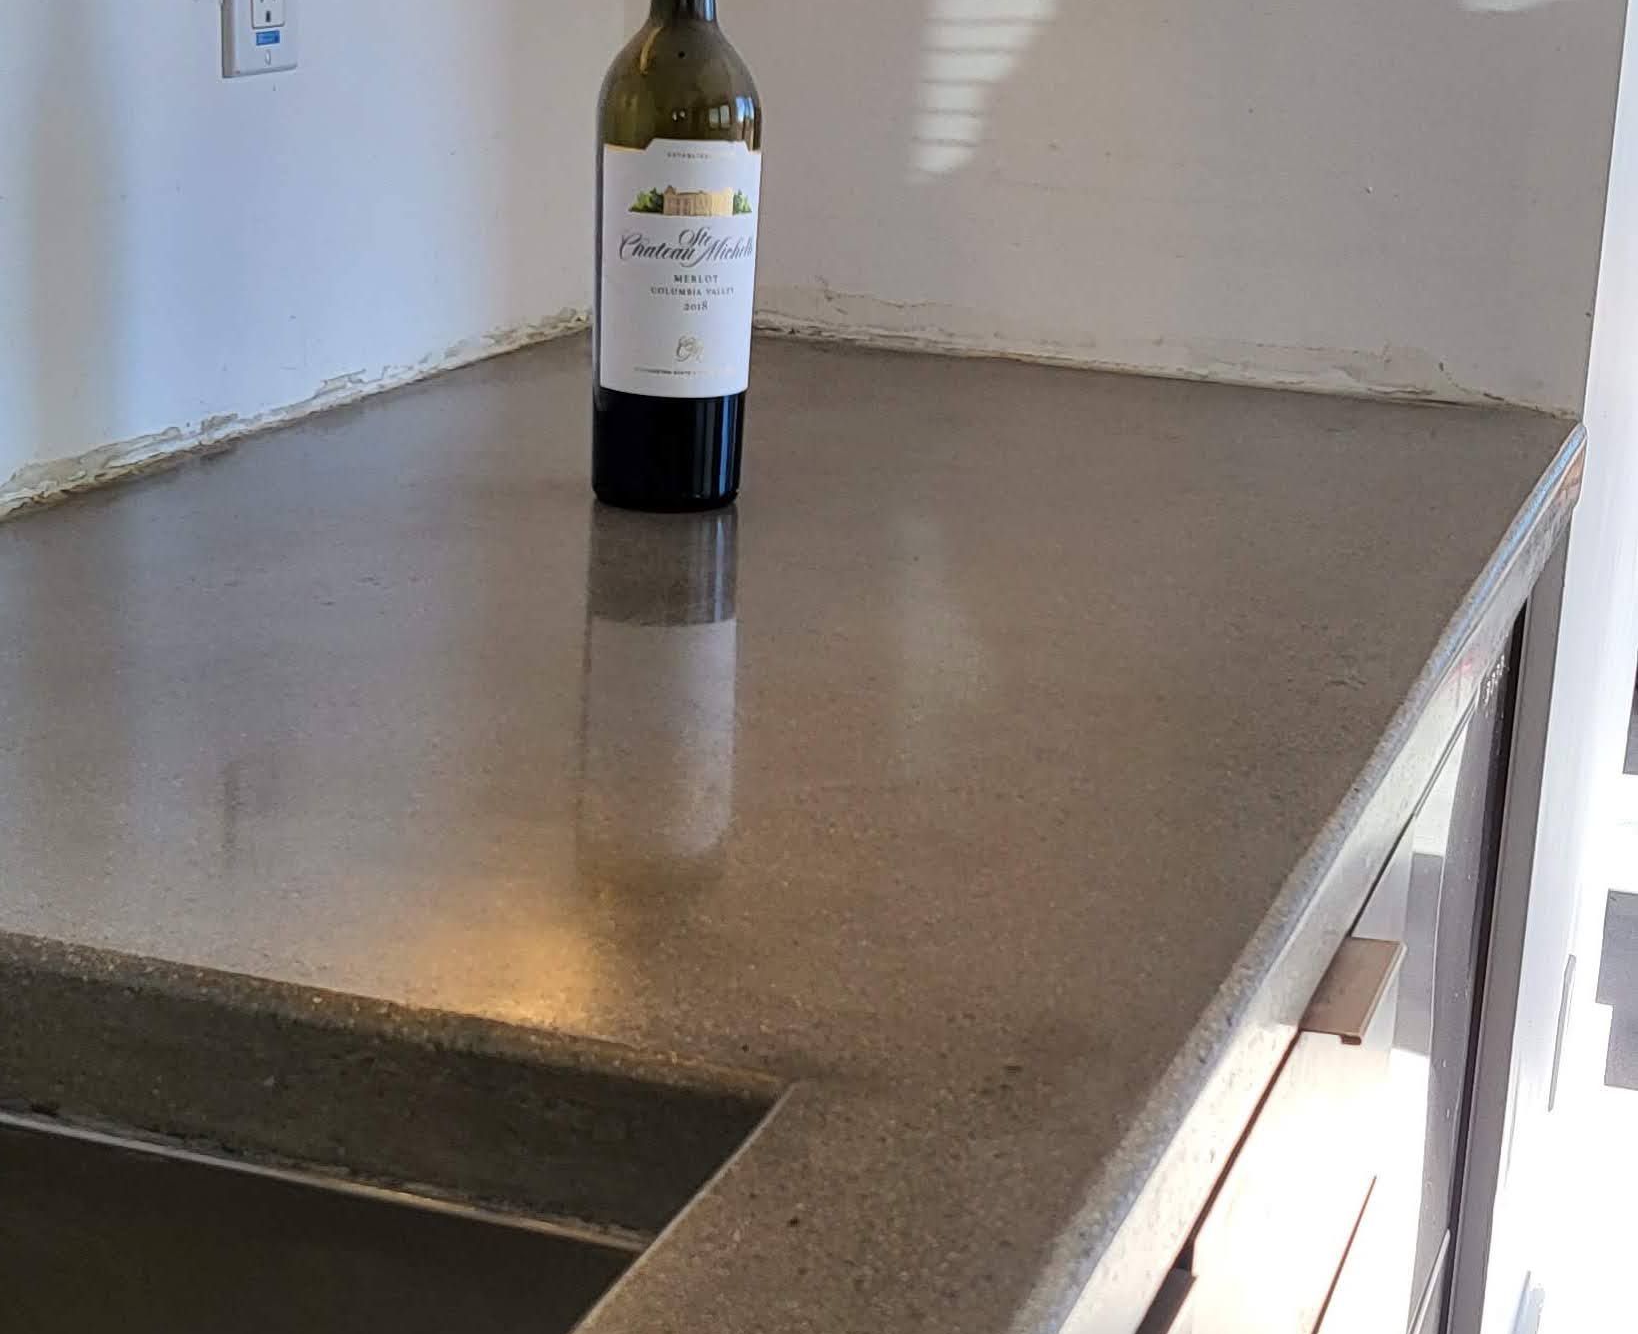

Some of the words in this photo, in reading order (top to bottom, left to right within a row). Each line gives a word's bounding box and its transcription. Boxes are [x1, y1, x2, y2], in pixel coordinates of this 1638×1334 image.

[620, 232, 695, 261] Chateau
[678, 227, 711, 246] Ste
[673, 274, 718, 284] MERLOT
[650, 286, 702, 296] COLUMBIA
[683, 299, 708, 311] 2018
